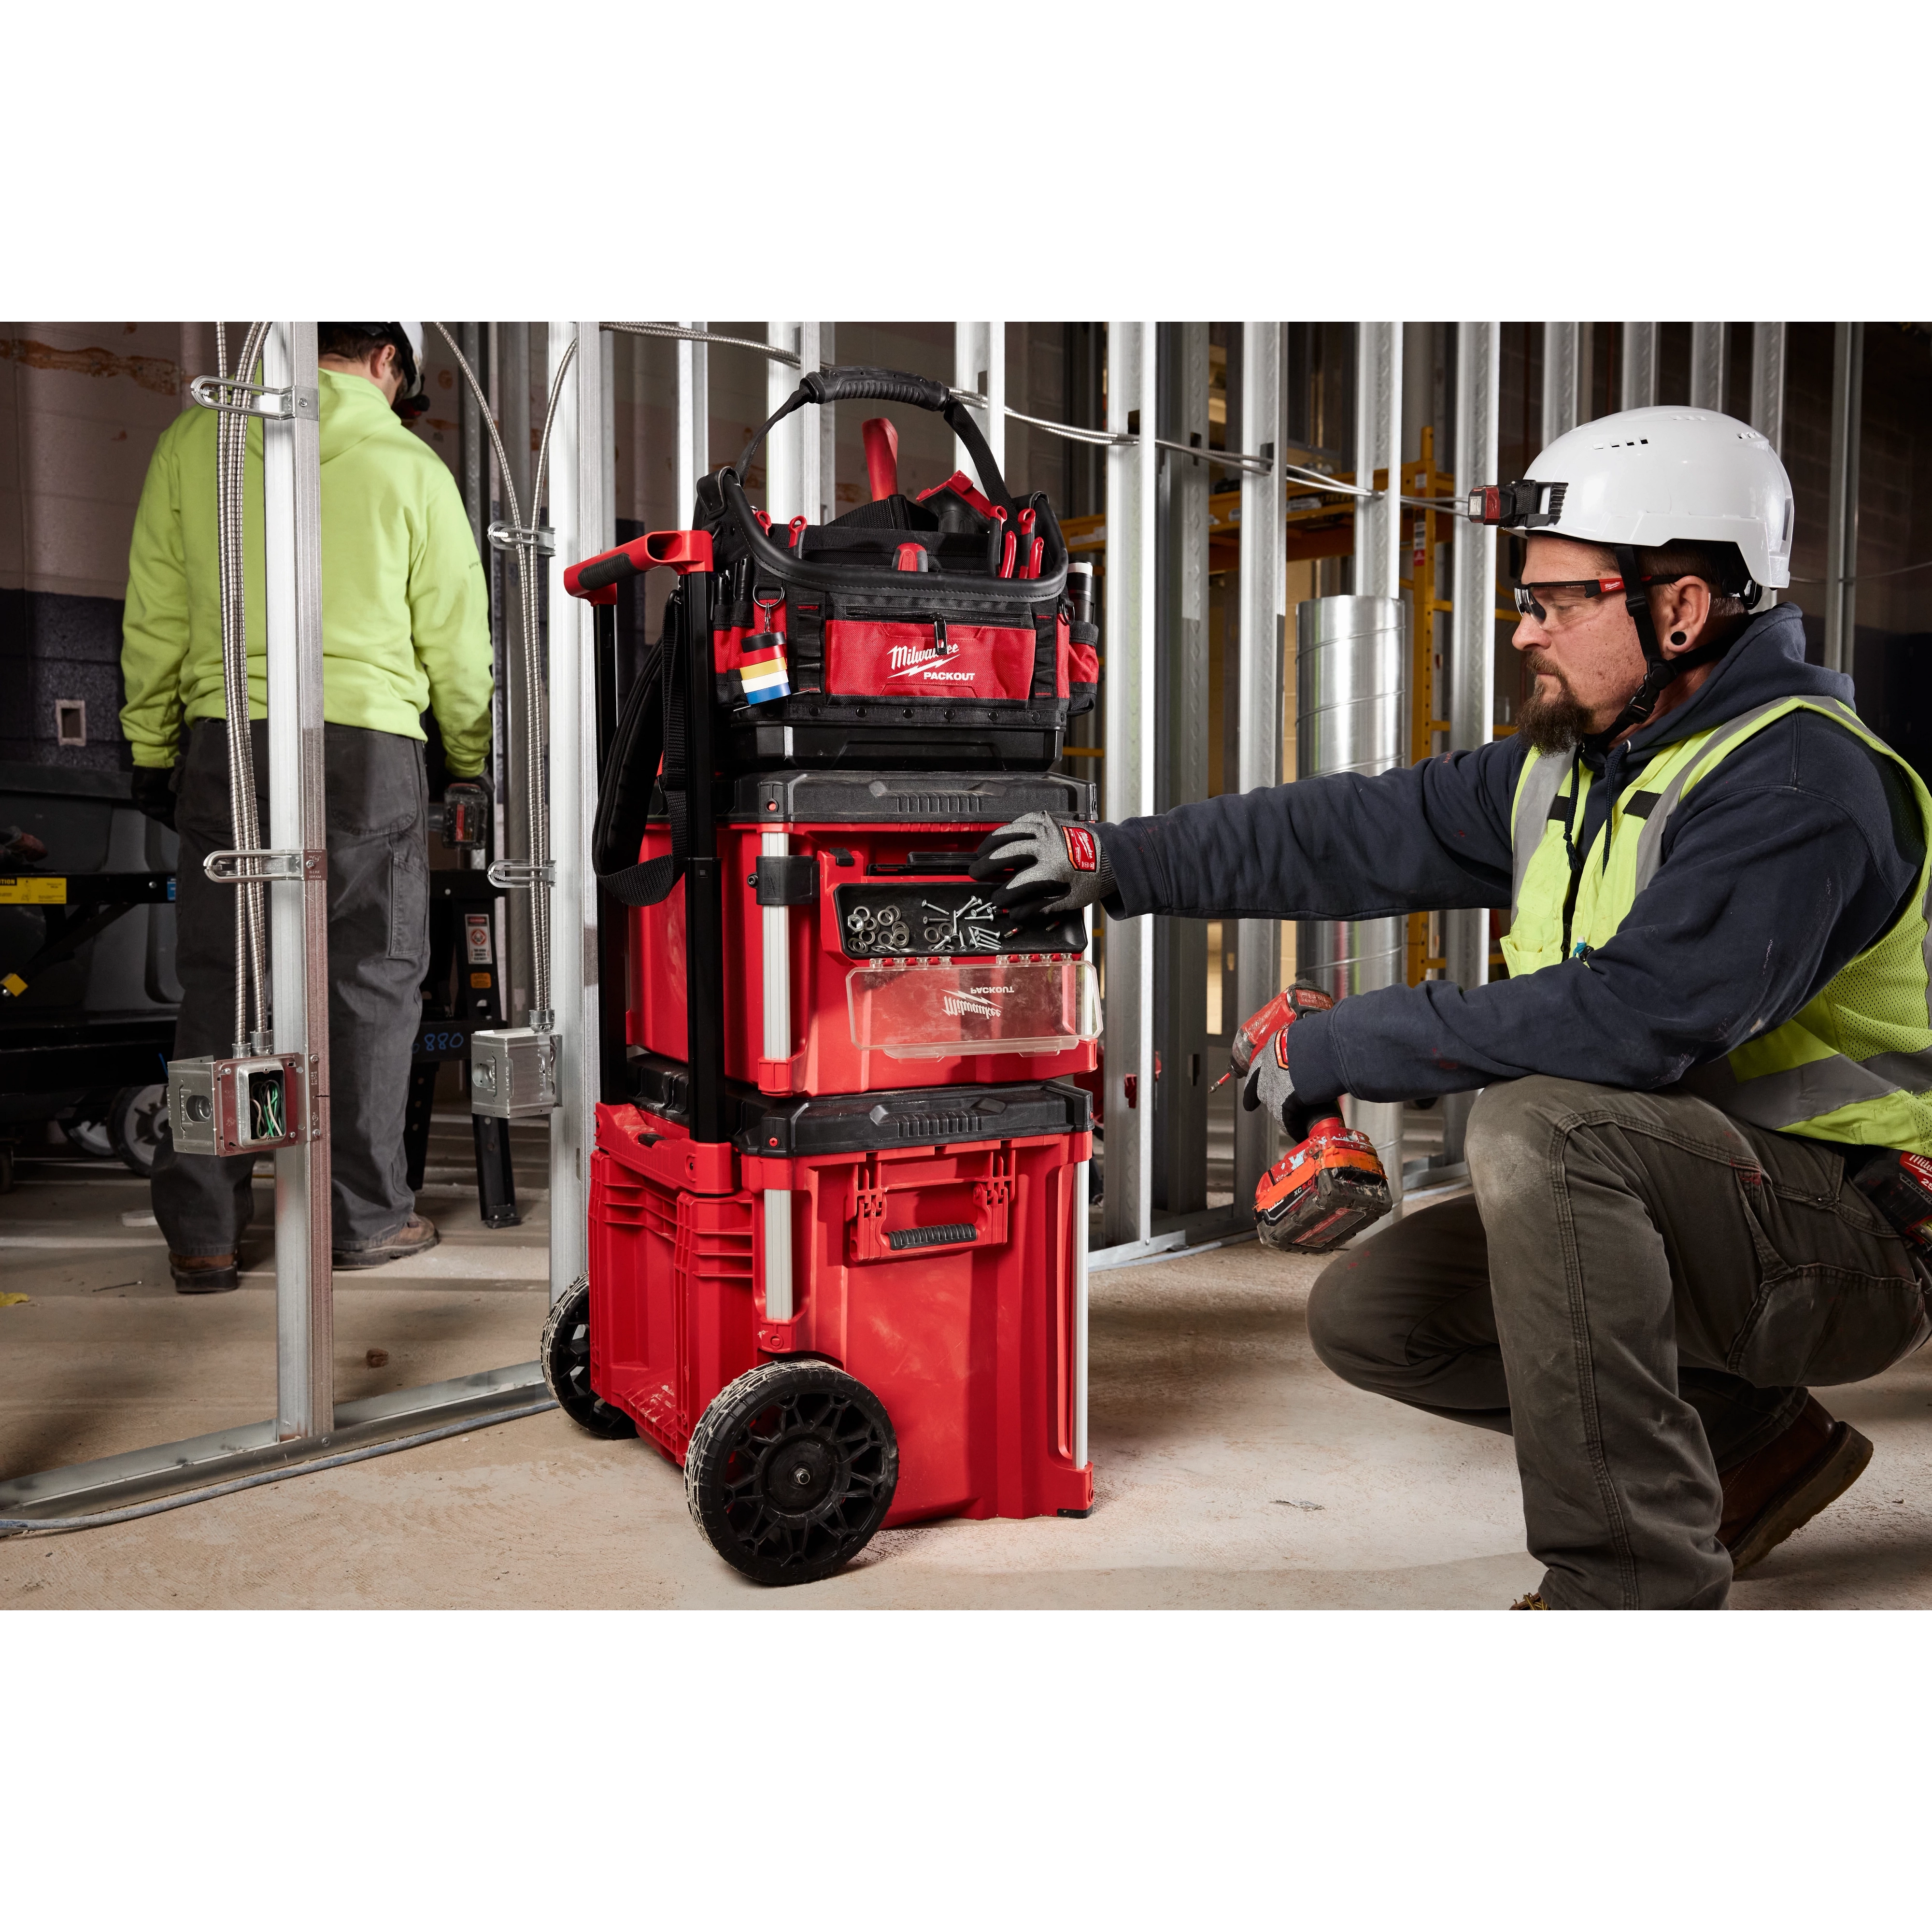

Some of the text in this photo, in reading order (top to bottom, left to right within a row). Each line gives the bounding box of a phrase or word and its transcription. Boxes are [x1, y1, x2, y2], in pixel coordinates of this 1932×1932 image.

[886, 641, 959, 670] Milwauee
[923, 672, 975, 681] PACKOUT
[1079, 832, 1093, 859] Milwaukee
[425, 1033, 464, 1051] 880
